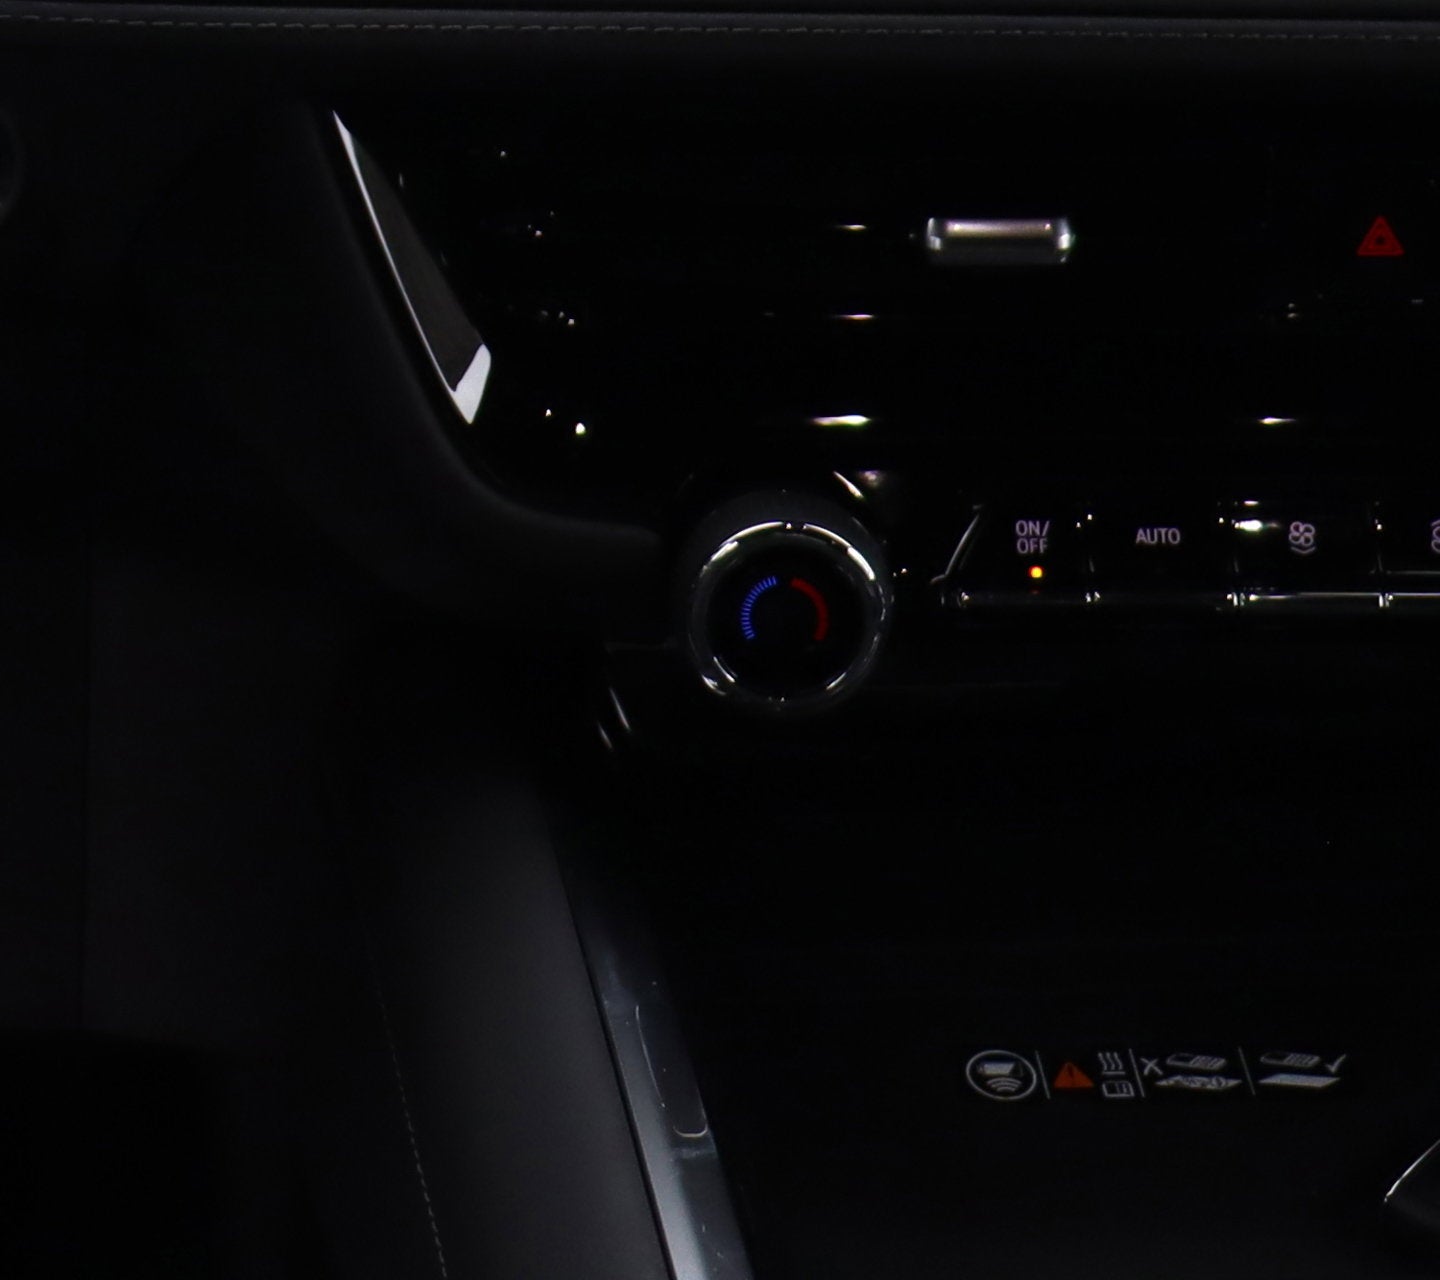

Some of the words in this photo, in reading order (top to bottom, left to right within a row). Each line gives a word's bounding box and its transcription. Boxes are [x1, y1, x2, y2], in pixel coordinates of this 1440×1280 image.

[1015, 519, 1051, 537] ON/
[1135, 528, 1181, 545] AUTO
[1016, 538, 1049, 555] OFF
